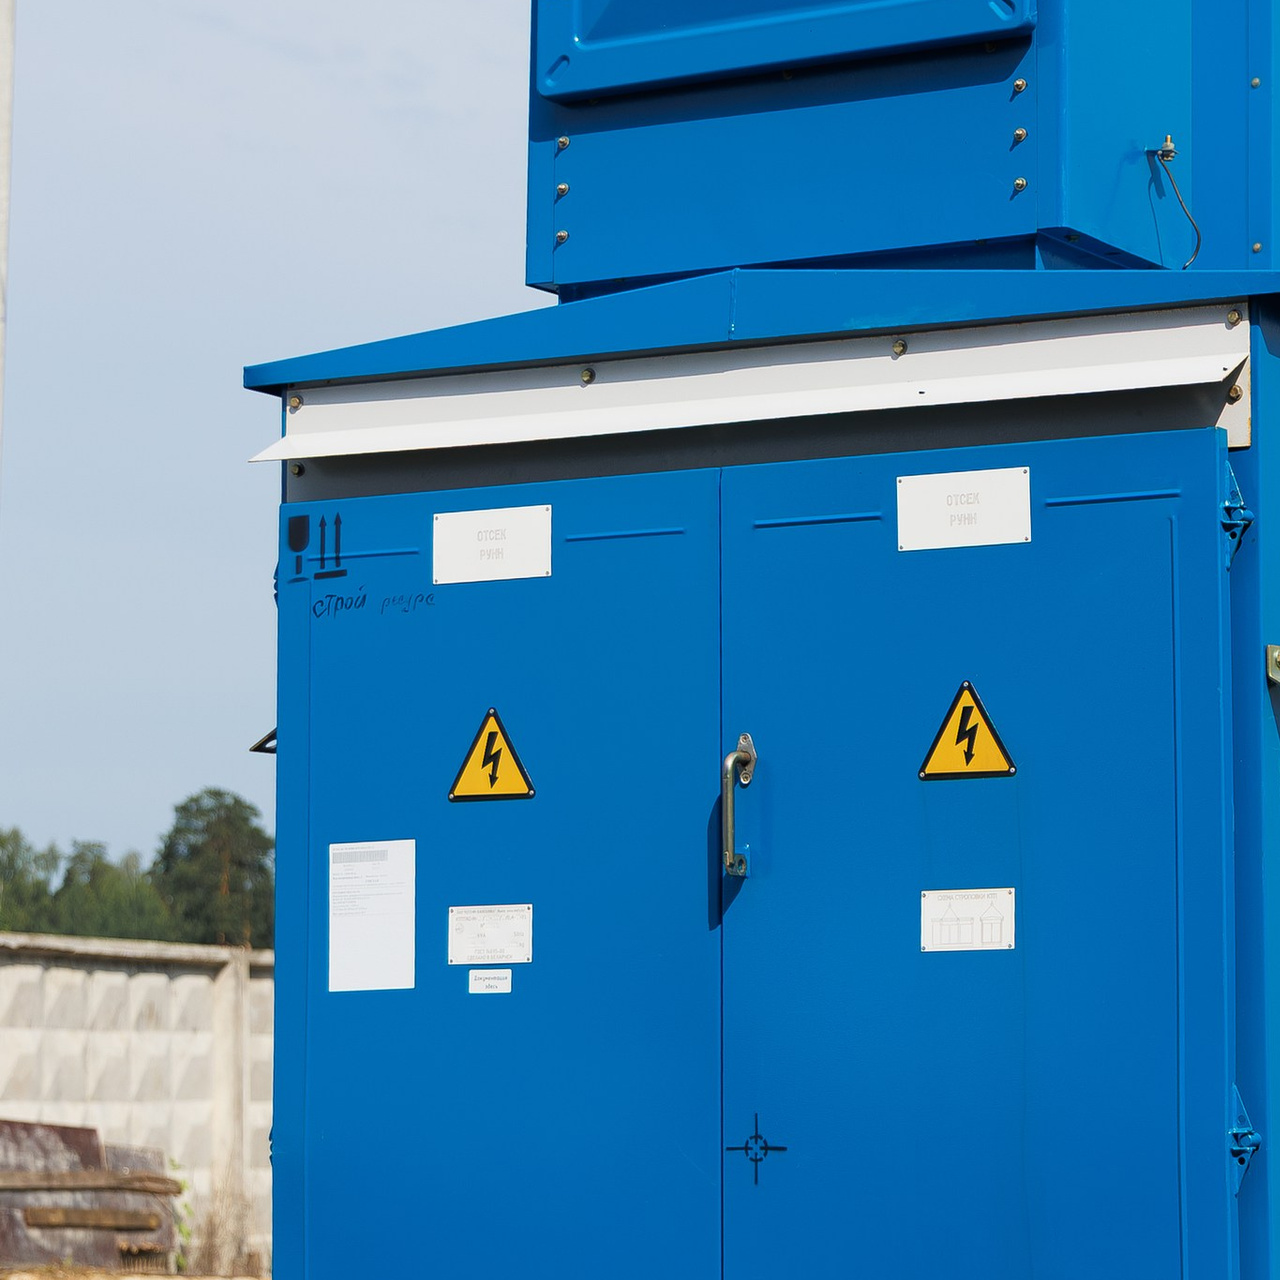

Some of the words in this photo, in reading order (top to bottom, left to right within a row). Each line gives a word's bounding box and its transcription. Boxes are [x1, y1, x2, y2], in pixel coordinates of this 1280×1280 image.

[946, 492, 980, 507] ОТСЕК
[950, 512, 977, 527] РУНН
[477, 528, 507, 542] ОТСЕК
[479, 547, 504, 561] РУНН
